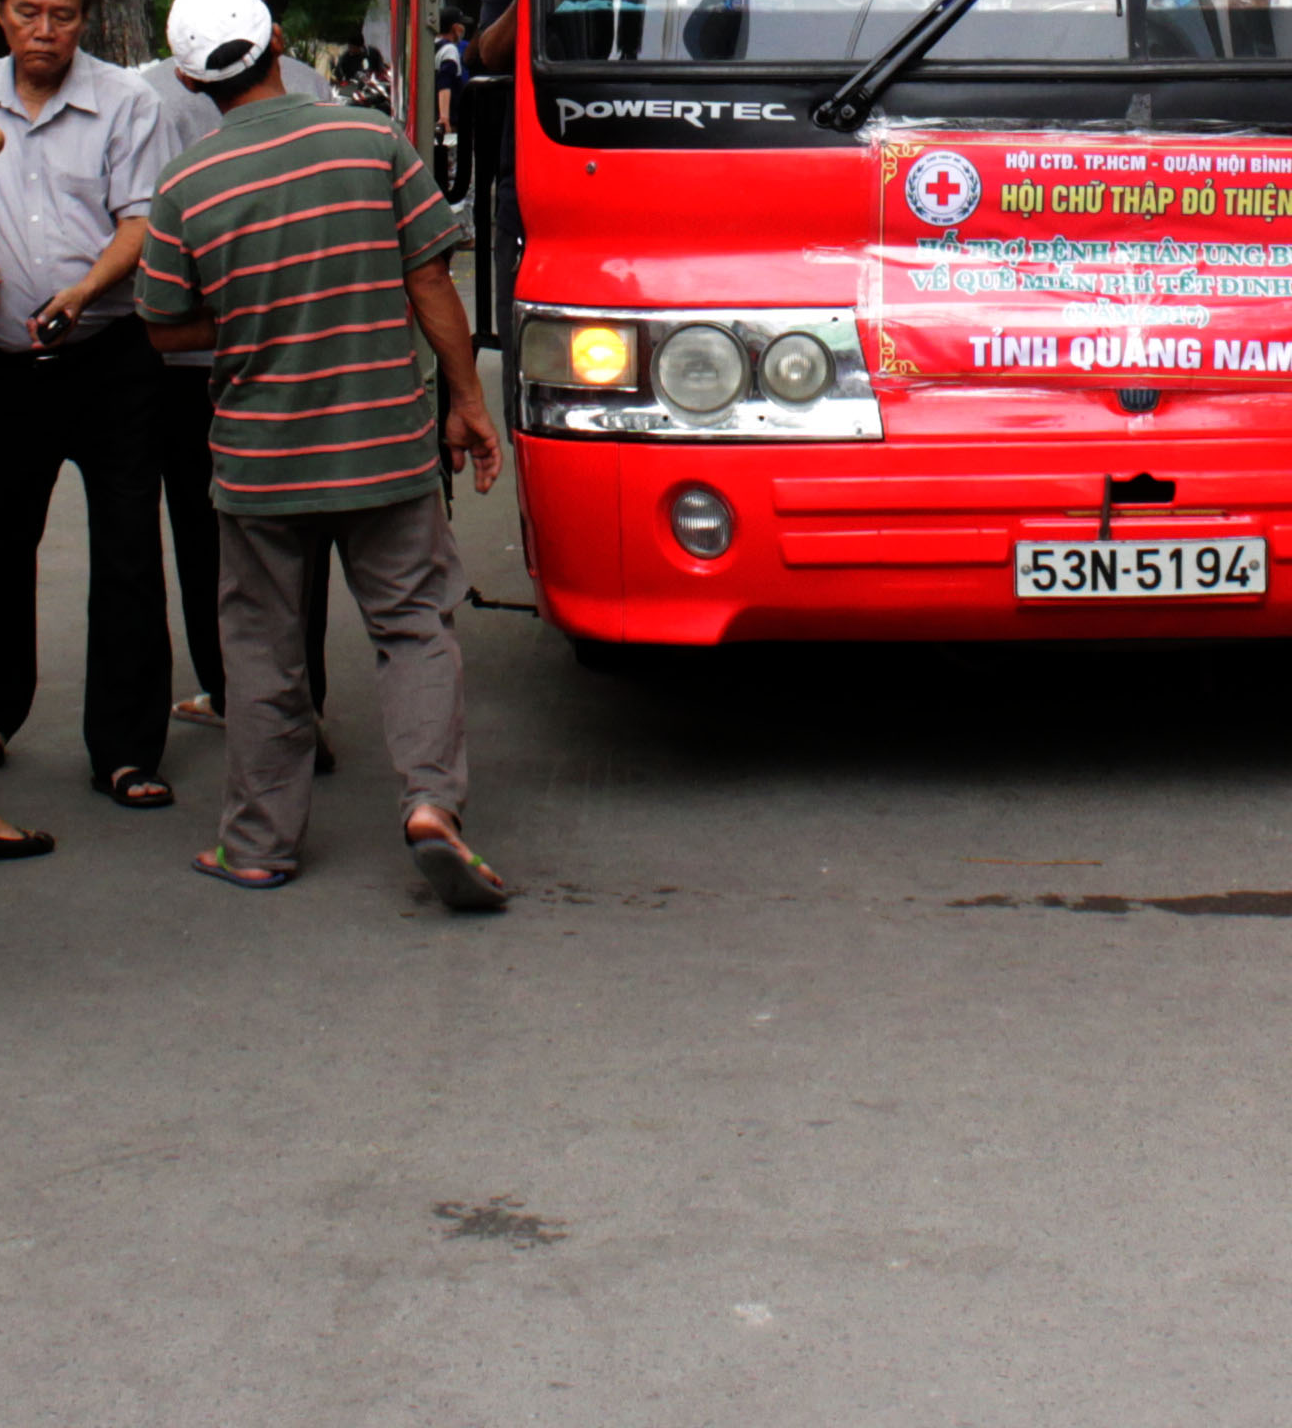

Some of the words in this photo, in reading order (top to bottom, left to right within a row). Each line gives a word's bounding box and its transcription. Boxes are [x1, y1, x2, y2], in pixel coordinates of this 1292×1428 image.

[556, 98, 796, 137] POWERTEC
[1005, 150, 1036, 173] HỘI
[1084, 154, 1147, 171] TP.HCM
[1163, 153, 1212, 176] QUẬN
[1216, 154, 1246, 176] HỘI
[1250, 154, 1292, 174] BÌNH
[1000, 178, 1045, 219] HỘI
[1051, 180, 1107, 214] CHỮ
[1110, 180, 1176, 221] THẬP
[1181, 178, 1217, 216] ĐỎ
[1029, 233, 1110, 266] BỆNH
[1115, 237, 1198, 265] NHÂN
[1202, 243, 1266, 267] UNG
[954, 265, 1017, 295] QUÊ
[1159, 268, 1216, 296] TẾT
[968, 326, 1057, 368] TỈNH
[1069, 326, 1202, 370] QUẢNG
[1031, 545, 1251, 592] 53N-5194
